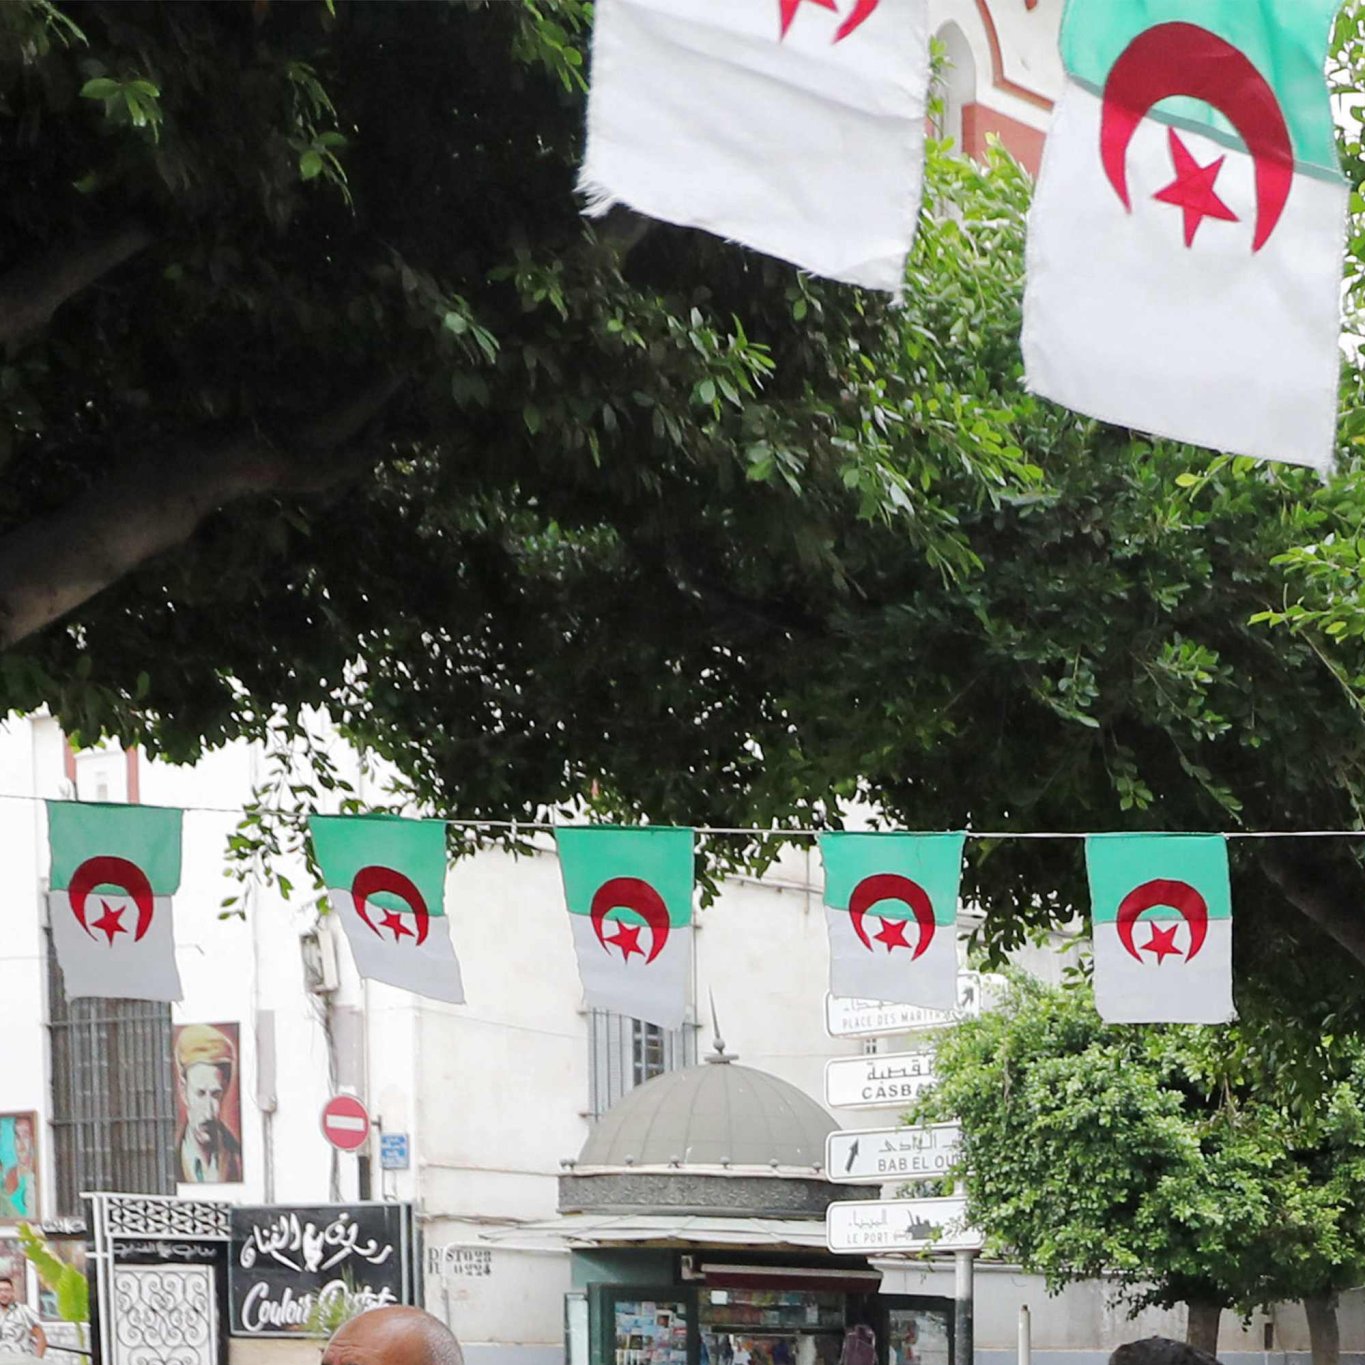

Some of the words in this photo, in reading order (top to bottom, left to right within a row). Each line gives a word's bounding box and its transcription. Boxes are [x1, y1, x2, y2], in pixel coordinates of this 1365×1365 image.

[842, 1015, 871, 1029] PLACE
[877, 1013, 896, 1027] DES
[878, 1157, 907, 1172] BAB
[912, 1156, 929, 1170] EL
[847, 1232, 858, 1244] LE
[864, 1231, 888, 1244] PORT
